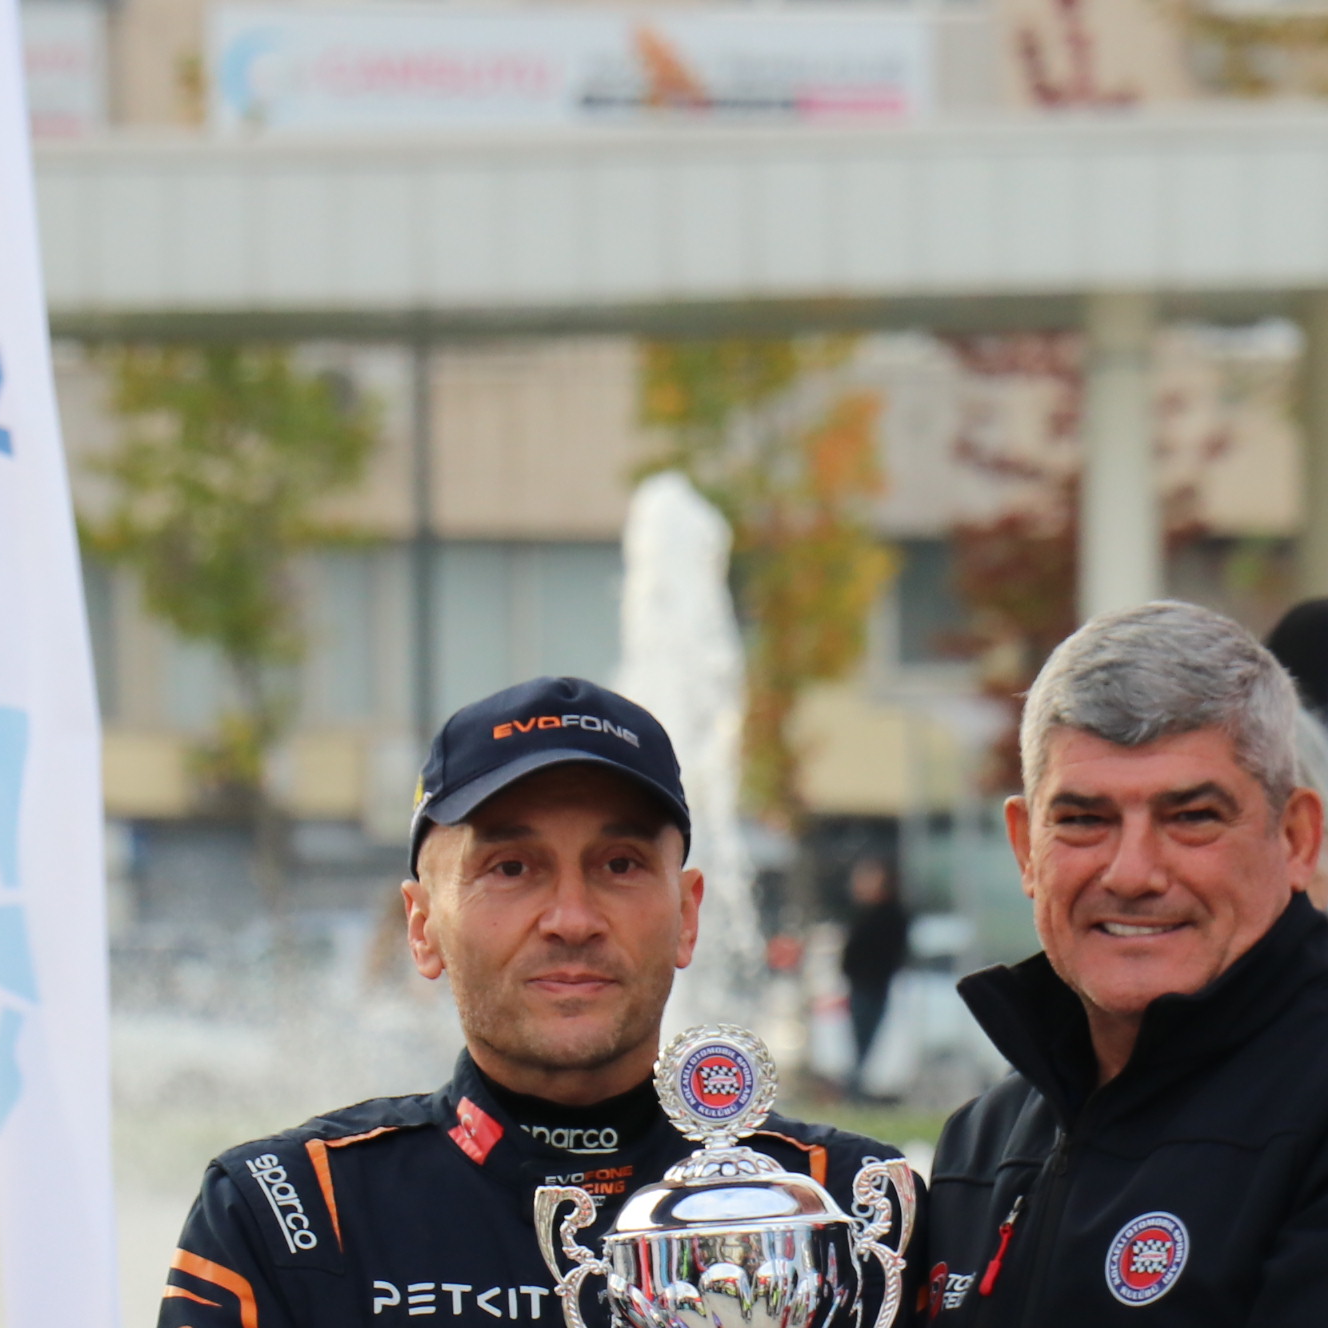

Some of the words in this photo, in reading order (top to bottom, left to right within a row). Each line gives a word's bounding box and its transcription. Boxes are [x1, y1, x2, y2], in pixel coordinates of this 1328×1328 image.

[492, 713, 640, 749] EVOFONE
[519, 1123, 619, 1153] parco
[544, 1165, 634, 1186] EVOFONE
[246, 1152, 318, 1254] sparco
[373, 1279, 551, 1320] PETKIT
